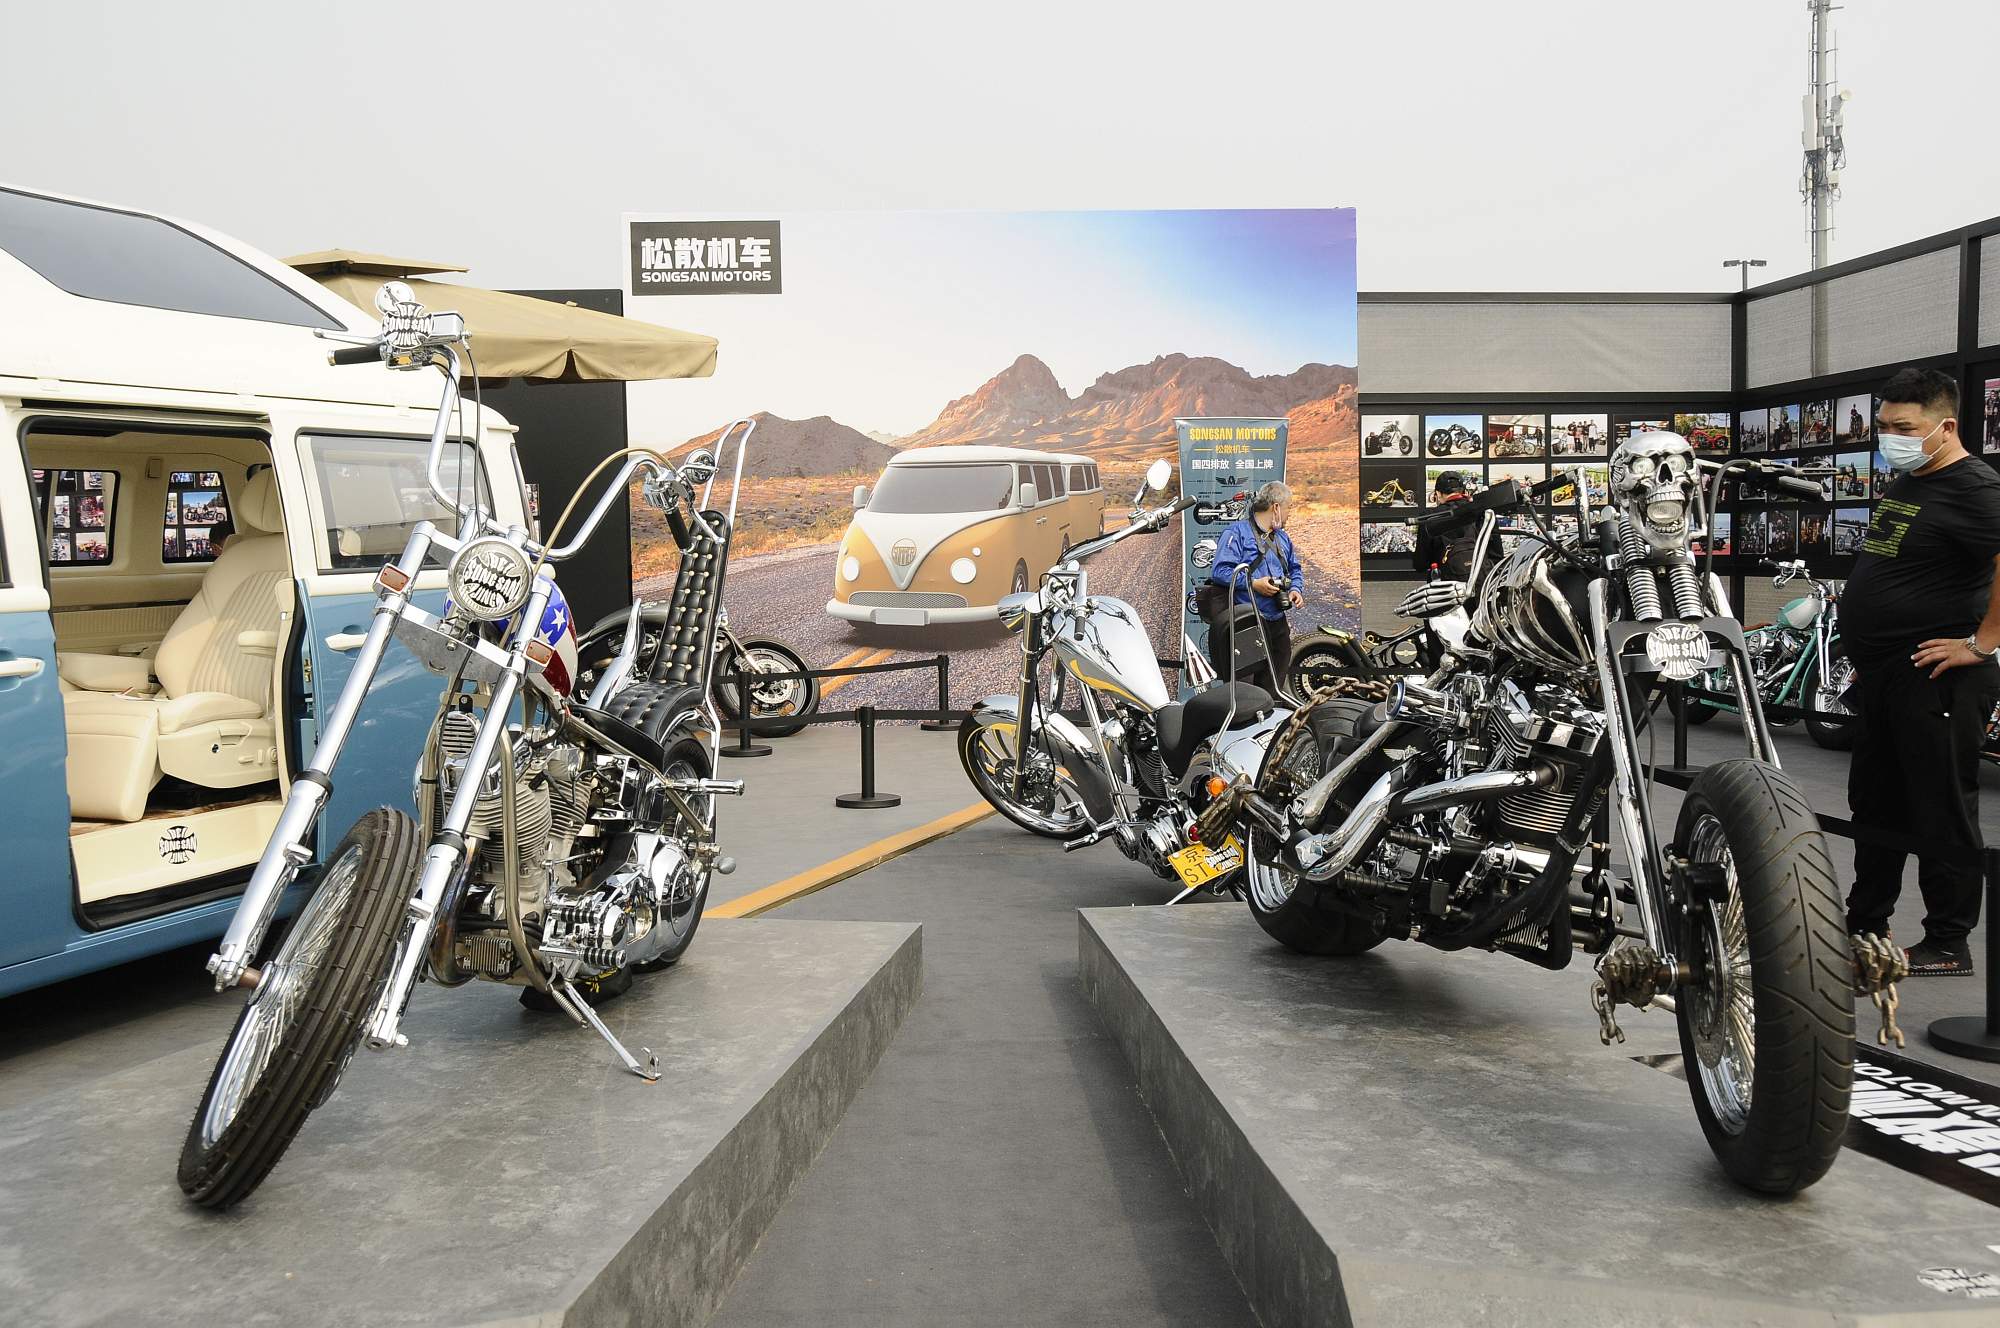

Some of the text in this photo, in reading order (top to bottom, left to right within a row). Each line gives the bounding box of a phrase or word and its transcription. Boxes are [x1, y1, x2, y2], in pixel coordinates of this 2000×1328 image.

[641, 237, 772, 269] 松散机车
[641, 270, 772, 283] SONGSAN MOTORS
[1189, 427, 1277, 440] SONGSAN MOTORS
[1215, 443, 1250, 455] 松散机车
[1191, 459, 1274, 470] 国四排放 全国上牌
